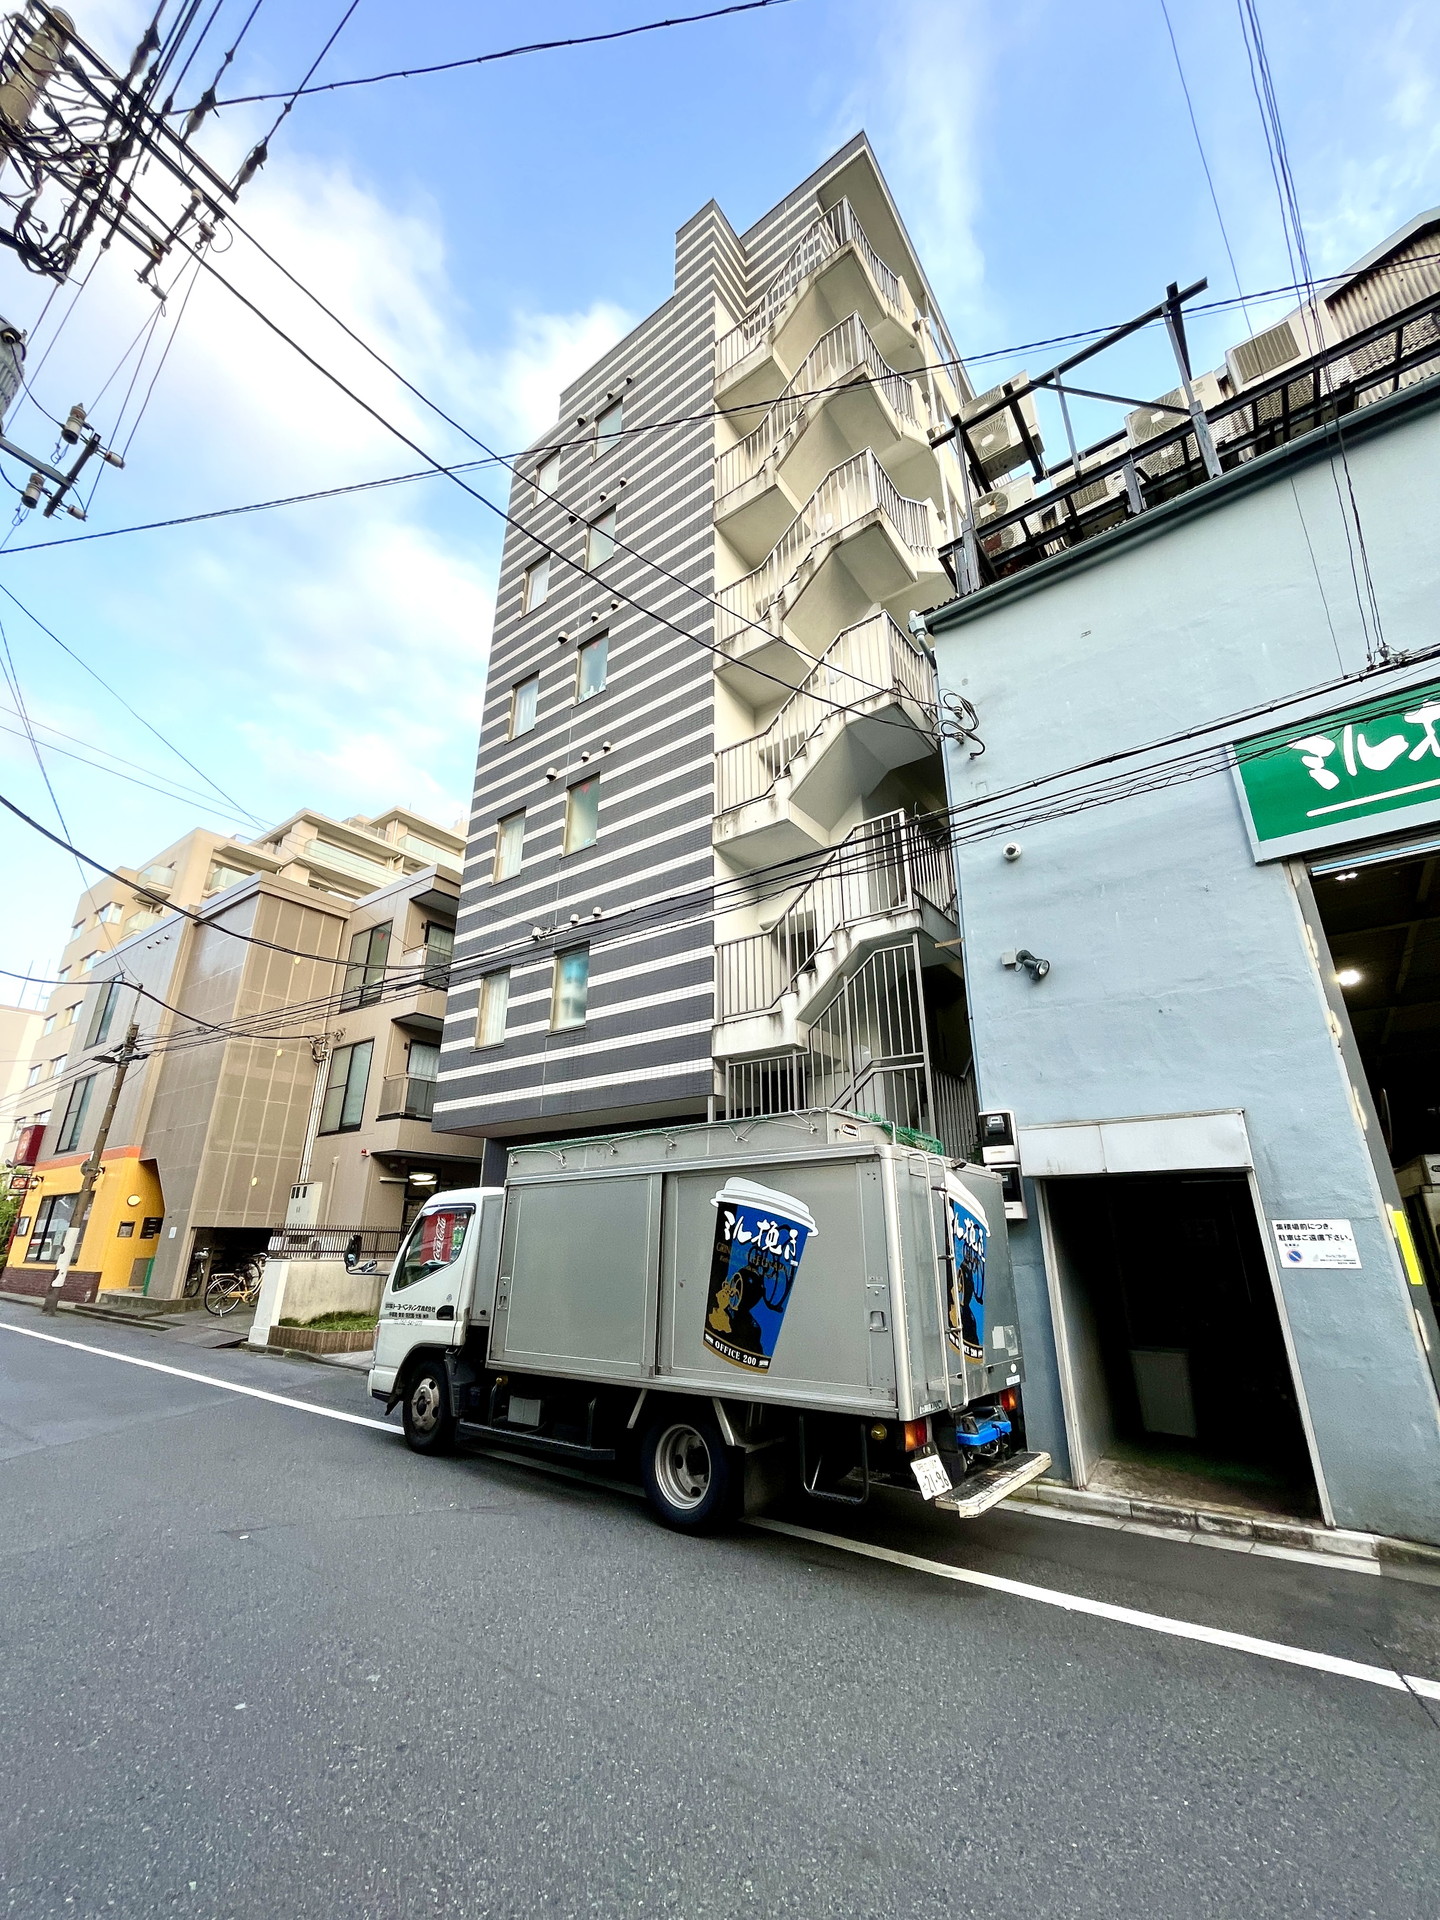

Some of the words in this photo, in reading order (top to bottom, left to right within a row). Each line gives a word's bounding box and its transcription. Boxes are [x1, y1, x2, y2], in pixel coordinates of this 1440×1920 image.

[1278, 1234, 1353, 1242] 駐車はご遠慮下さい。
[714, 1340, 741, 1360] OFFICE
[742, 1354, 757, 1366] 200
